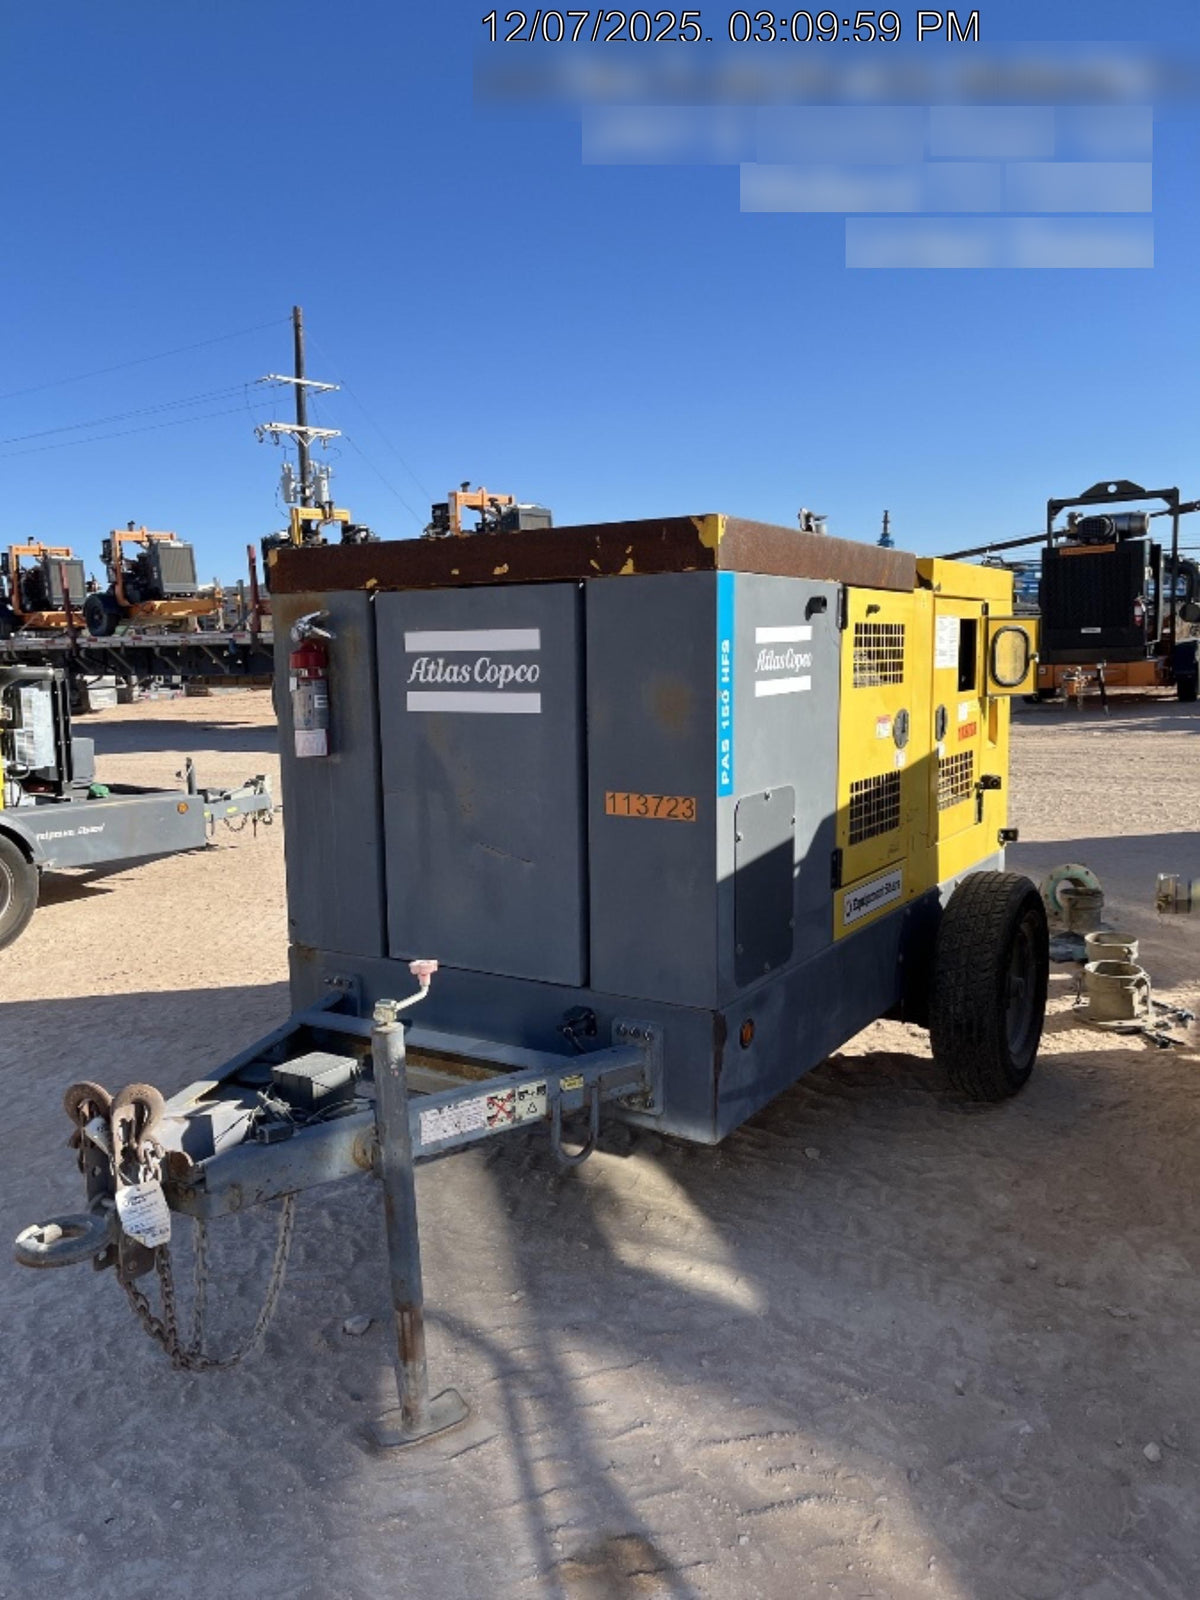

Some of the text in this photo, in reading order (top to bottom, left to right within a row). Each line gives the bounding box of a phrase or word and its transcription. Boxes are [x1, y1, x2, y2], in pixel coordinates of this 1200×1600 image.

[406, 657, 540, 689] Atlas Copco
[755, 648, 785, 672] Atlas
[720, 739, 731, 785] PAS
[608, 793, 695, 819] 113723
